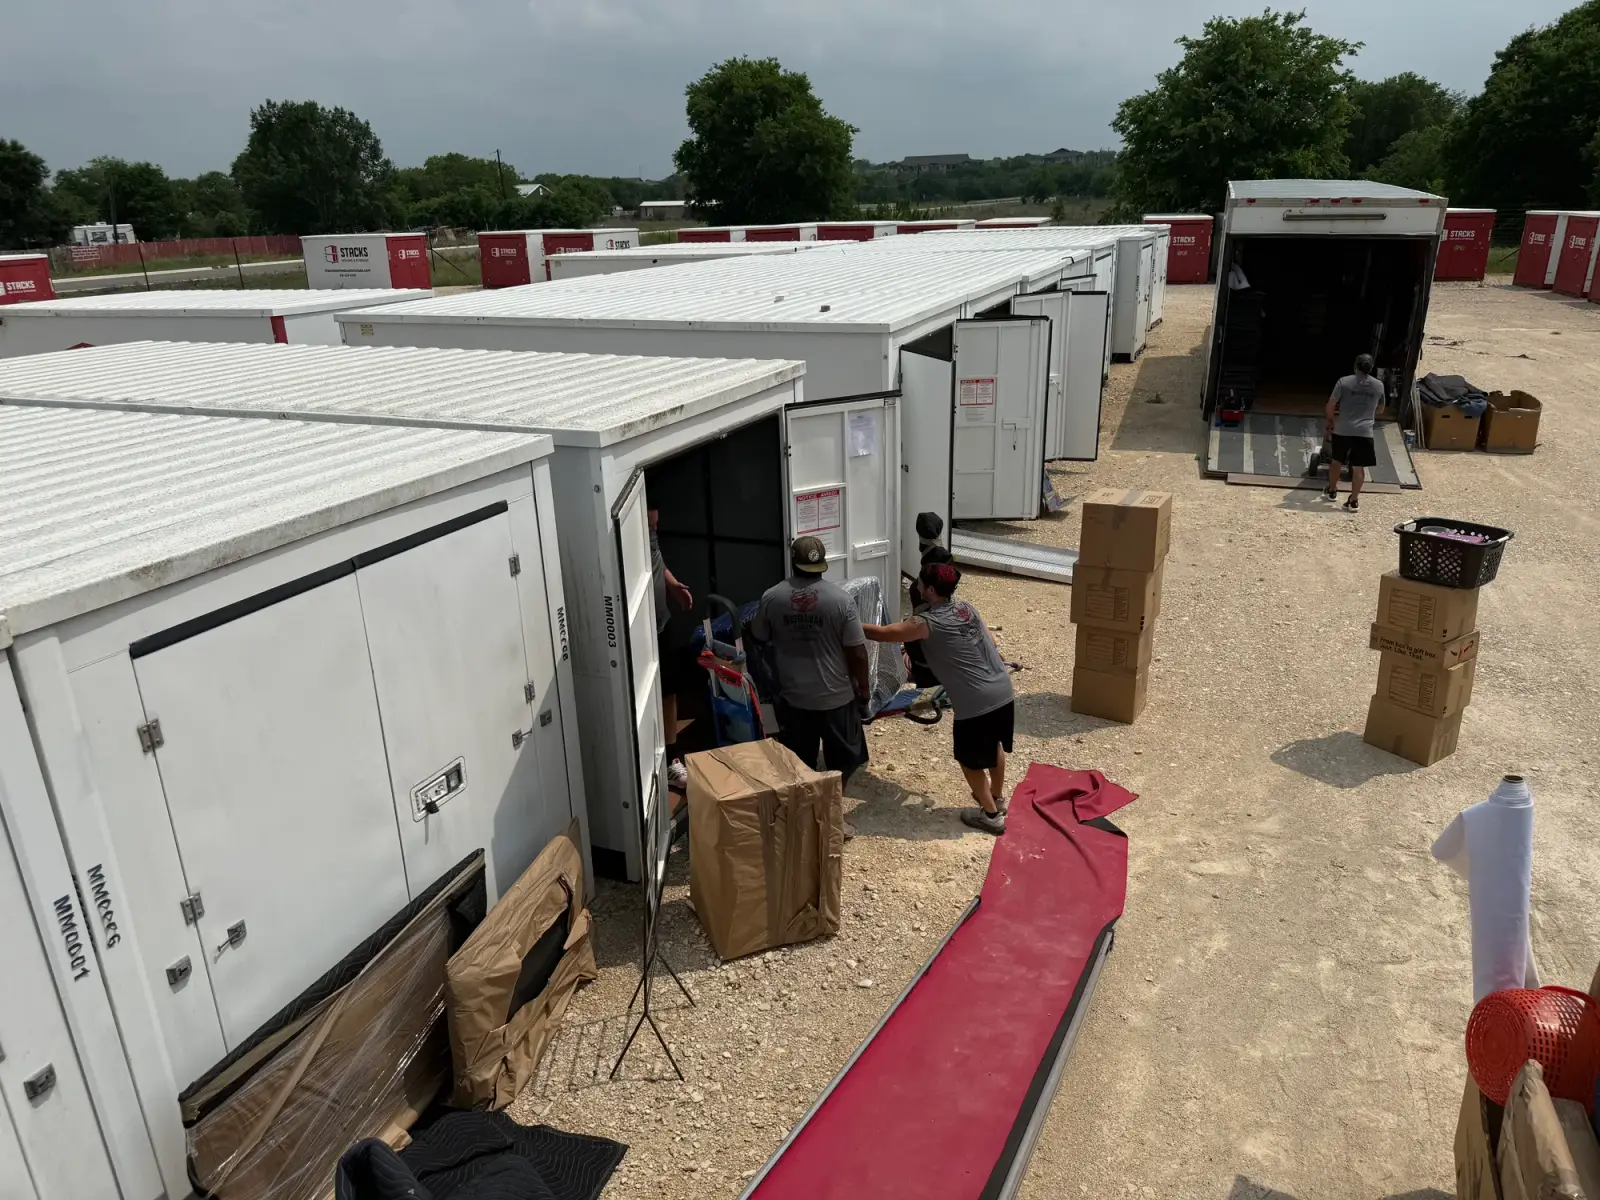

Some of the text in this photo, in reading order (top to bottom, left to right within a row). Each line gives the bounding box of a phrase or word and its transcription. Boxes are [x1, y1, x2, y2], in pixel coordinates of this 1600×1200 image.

[340, 247, 369, 258] STACKS
[6, 280, 36, 290] STACKS
[603, 595, 617, 648] MM0003
[1380, 637, 1395, 646] From
[1396, 641, 1406, 649] box
[53, 894, 90, 982] MM0001
